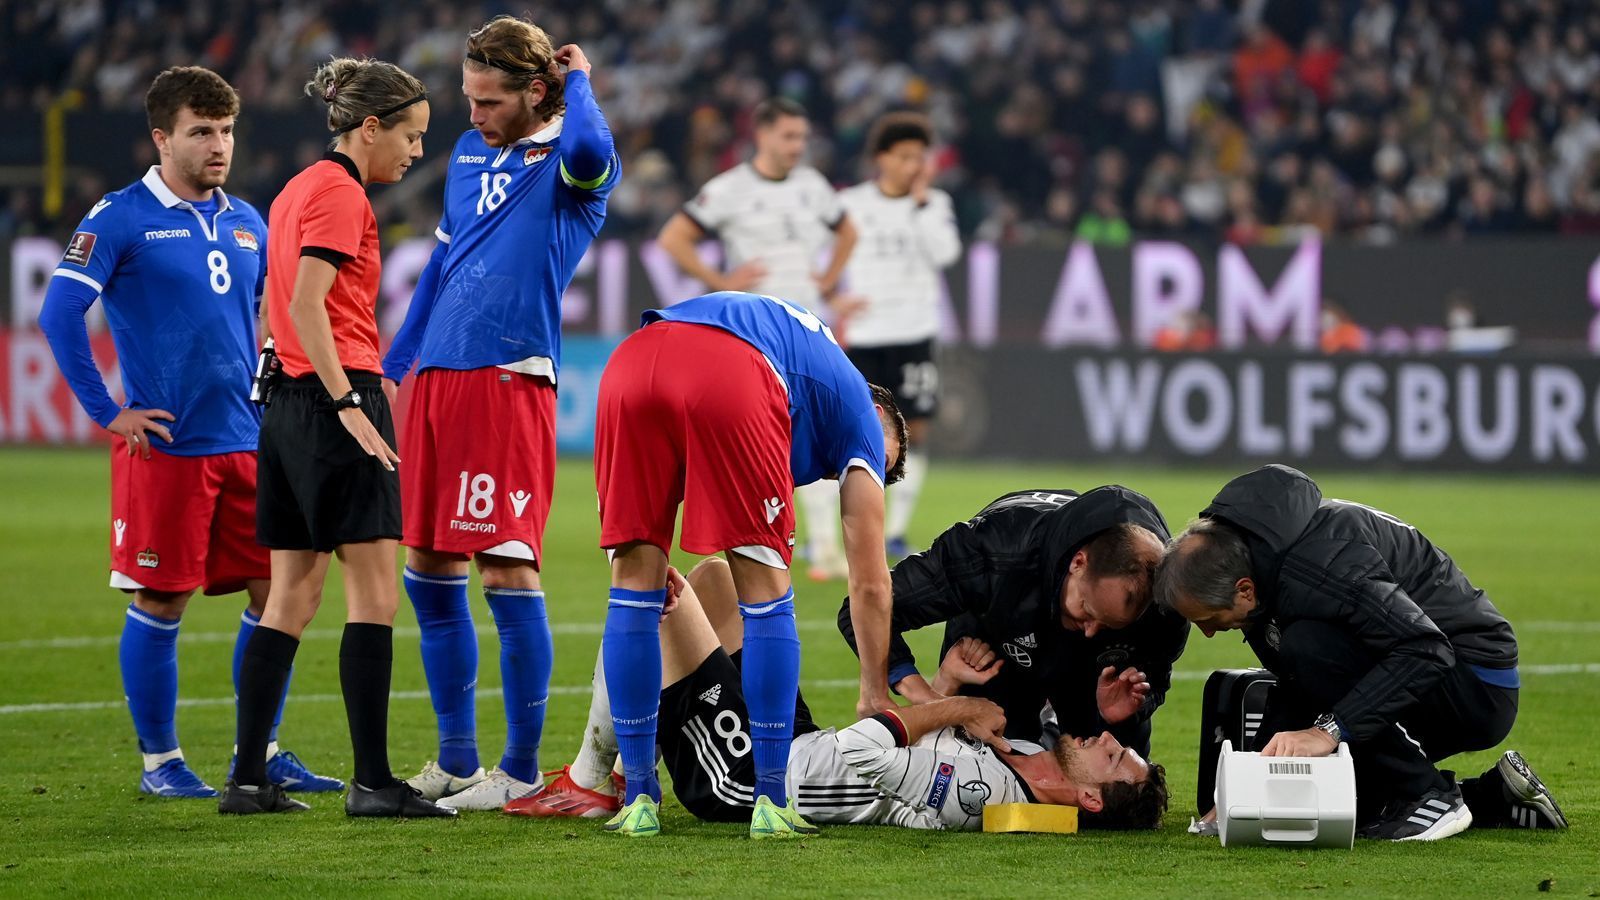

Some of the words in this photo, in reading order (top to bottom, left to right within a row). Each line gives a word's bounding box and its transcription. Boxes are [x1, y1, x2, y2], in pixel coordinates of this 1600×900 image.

[456, 155, 487, 165] macron
[476, 172, 513, 216] 18
[145, 229, 191, 241] macron
[207, 250, 231, 295] 8
[1075, 358, 1600, 465] WOLFSBUR
[456, 471, 496, 519] 18
[450, 520, 496, 533] macron
[698, 683, 722, 701] adidas
[714, 709, 752, 758] 8
[930, 775, 947, 808] RESPECT
